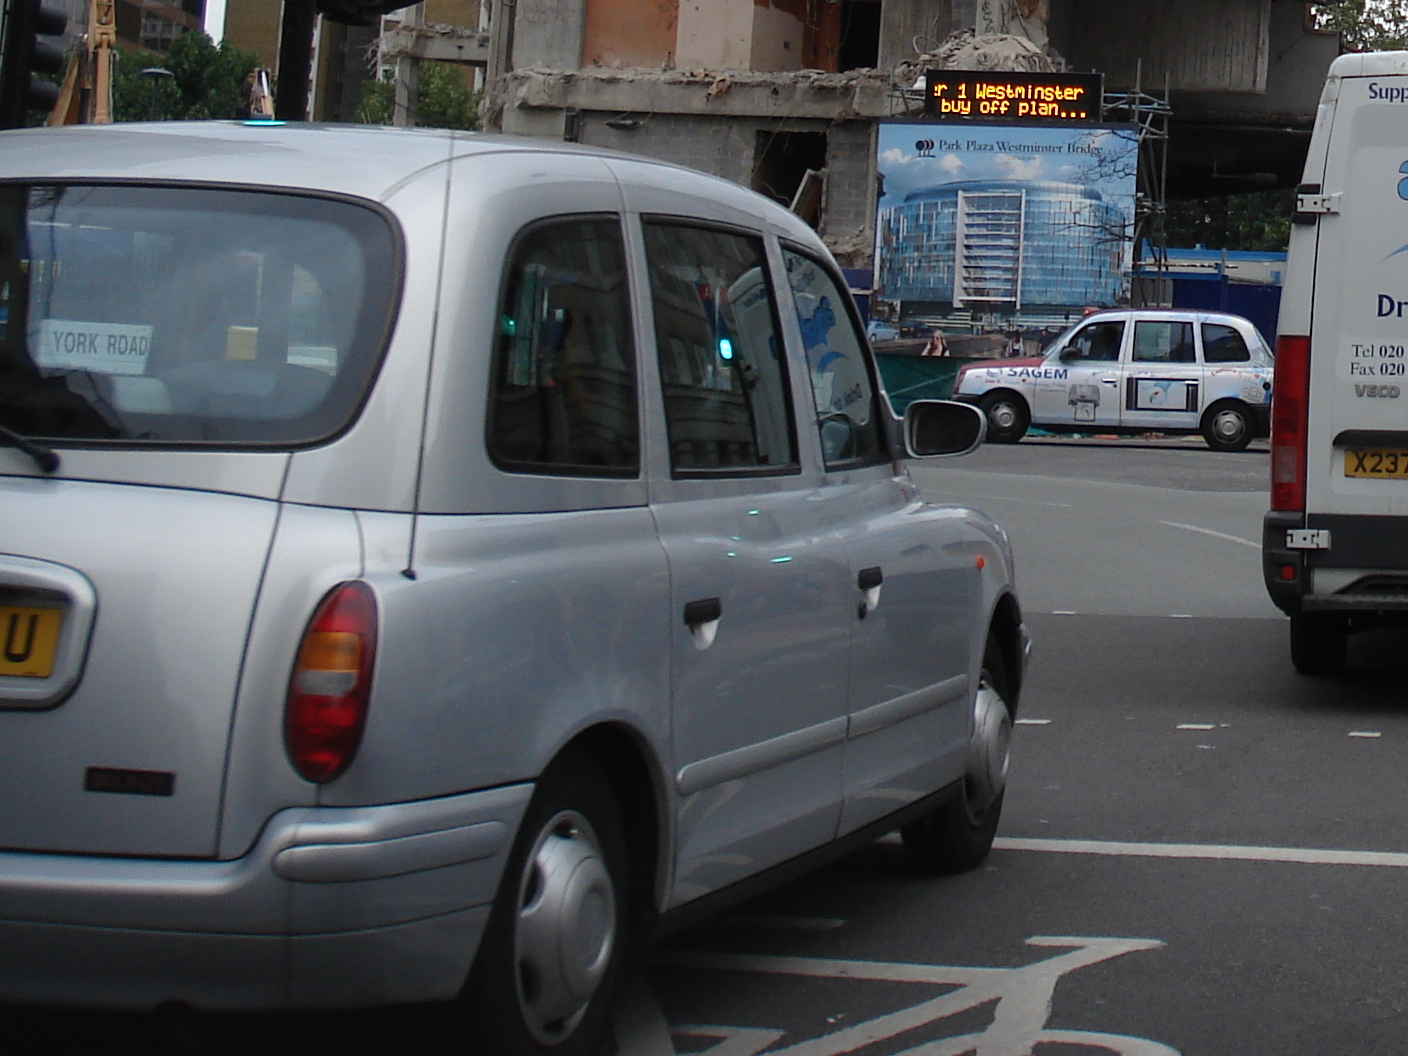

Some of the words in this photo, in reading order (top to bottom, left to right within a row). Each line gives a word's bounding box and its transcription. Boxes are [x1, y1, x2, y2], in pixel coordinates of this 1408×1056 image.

[958, 83, 967, 99] 1
[976, 83, 1084, 102] Westminster
[941, 98, 971, 115] buy
[979, 100, 1010, 114] off
[1018, 101, 1086, 118] plan...
[939, 139, 962, 151] Park
[966, 140, 994, 152] Plaza
[996, 141, 1062, 153] Westminster
[1066, 141, 1103, 157] Bridge
[53, 331, 99, 354] YORK
[107, 335, 148, 355] ROAD
[1352, 344, 1374, 358] Tel
[1379, 345, 1404, 358] 020
[1007, 368, 1068, 380] SAGEM
[1350, 362, 1375, 376] Fax
[1380, 363, 1405, 376] 020
